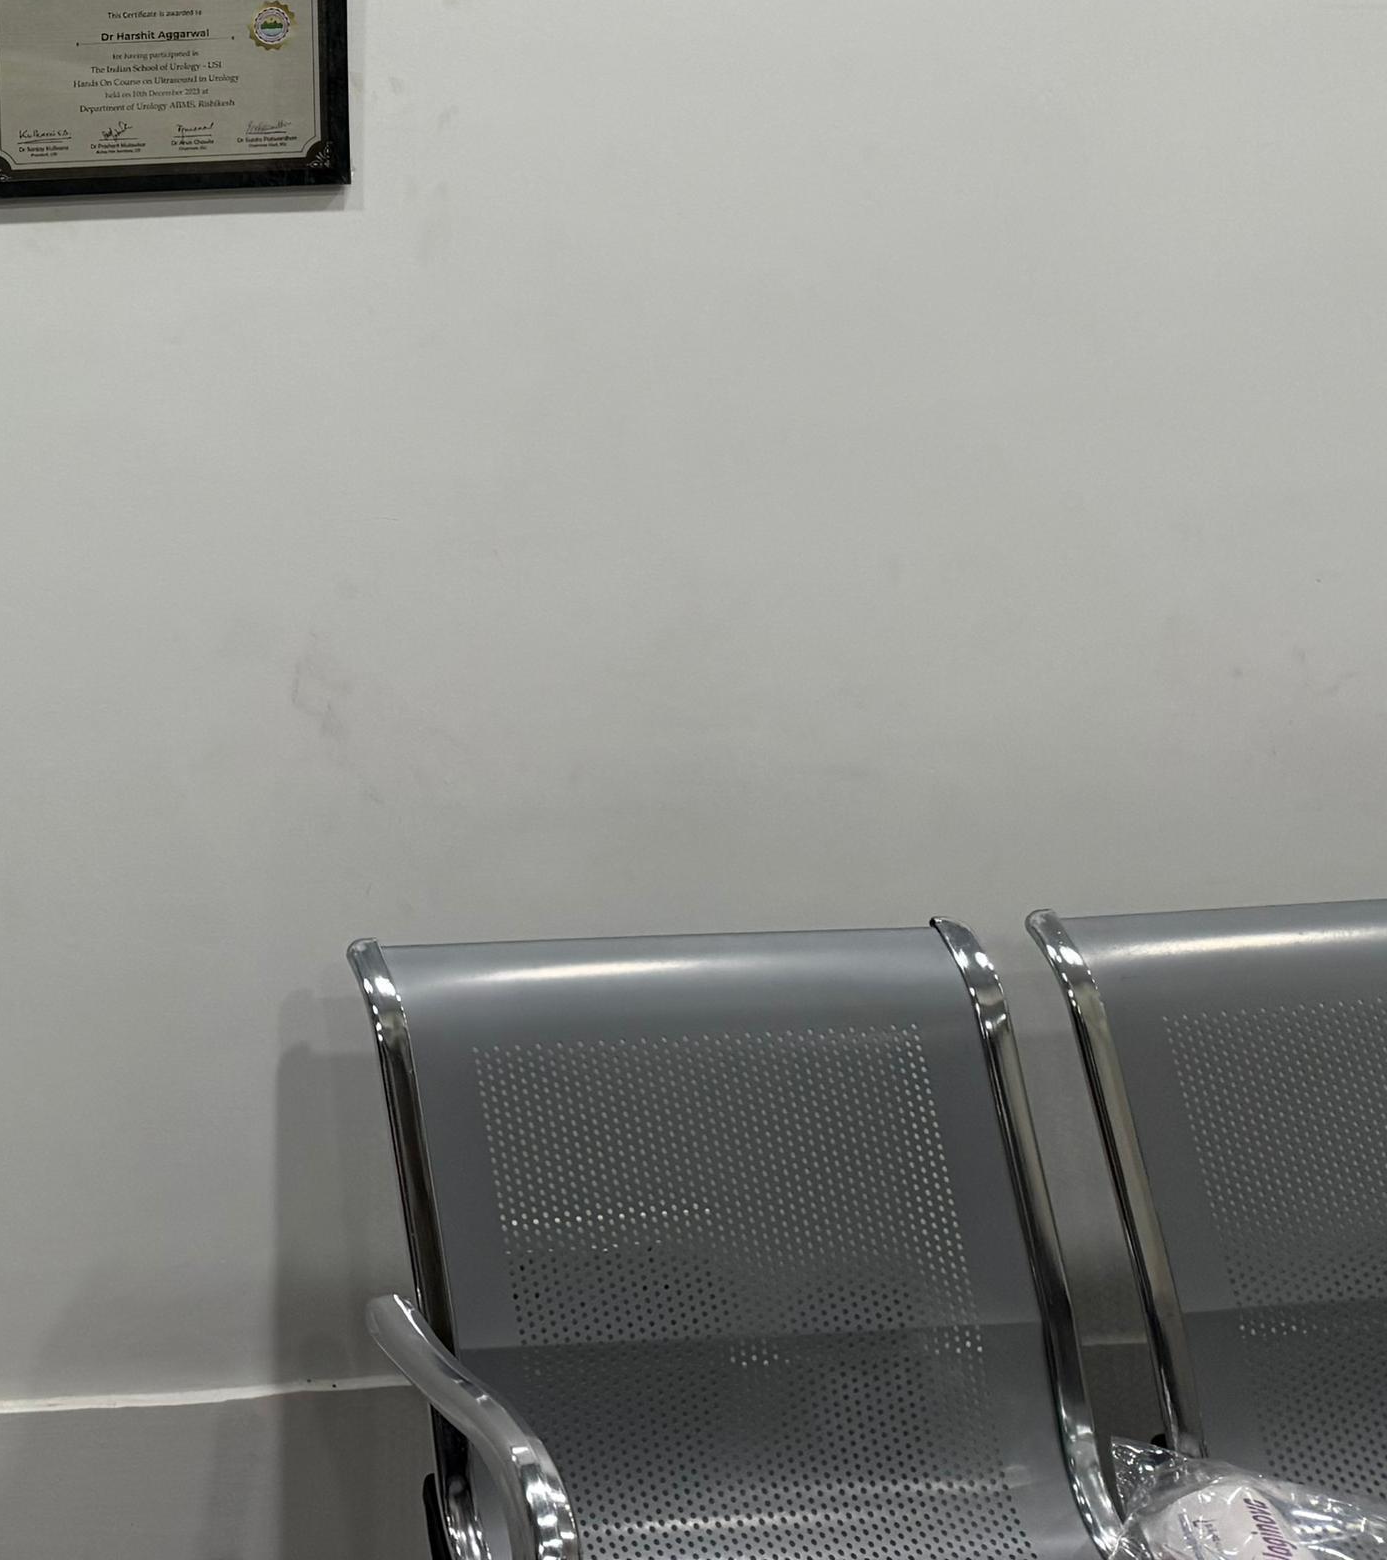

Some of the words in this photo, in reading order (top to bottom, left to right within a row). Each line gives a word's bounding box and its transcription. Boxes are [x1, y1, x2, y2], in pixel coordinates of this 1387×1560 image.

[101, 33, 114, 41] Dr
[117, 31, 155, 40] Harshit
[158, 29, 209, 41] Aggarwal
